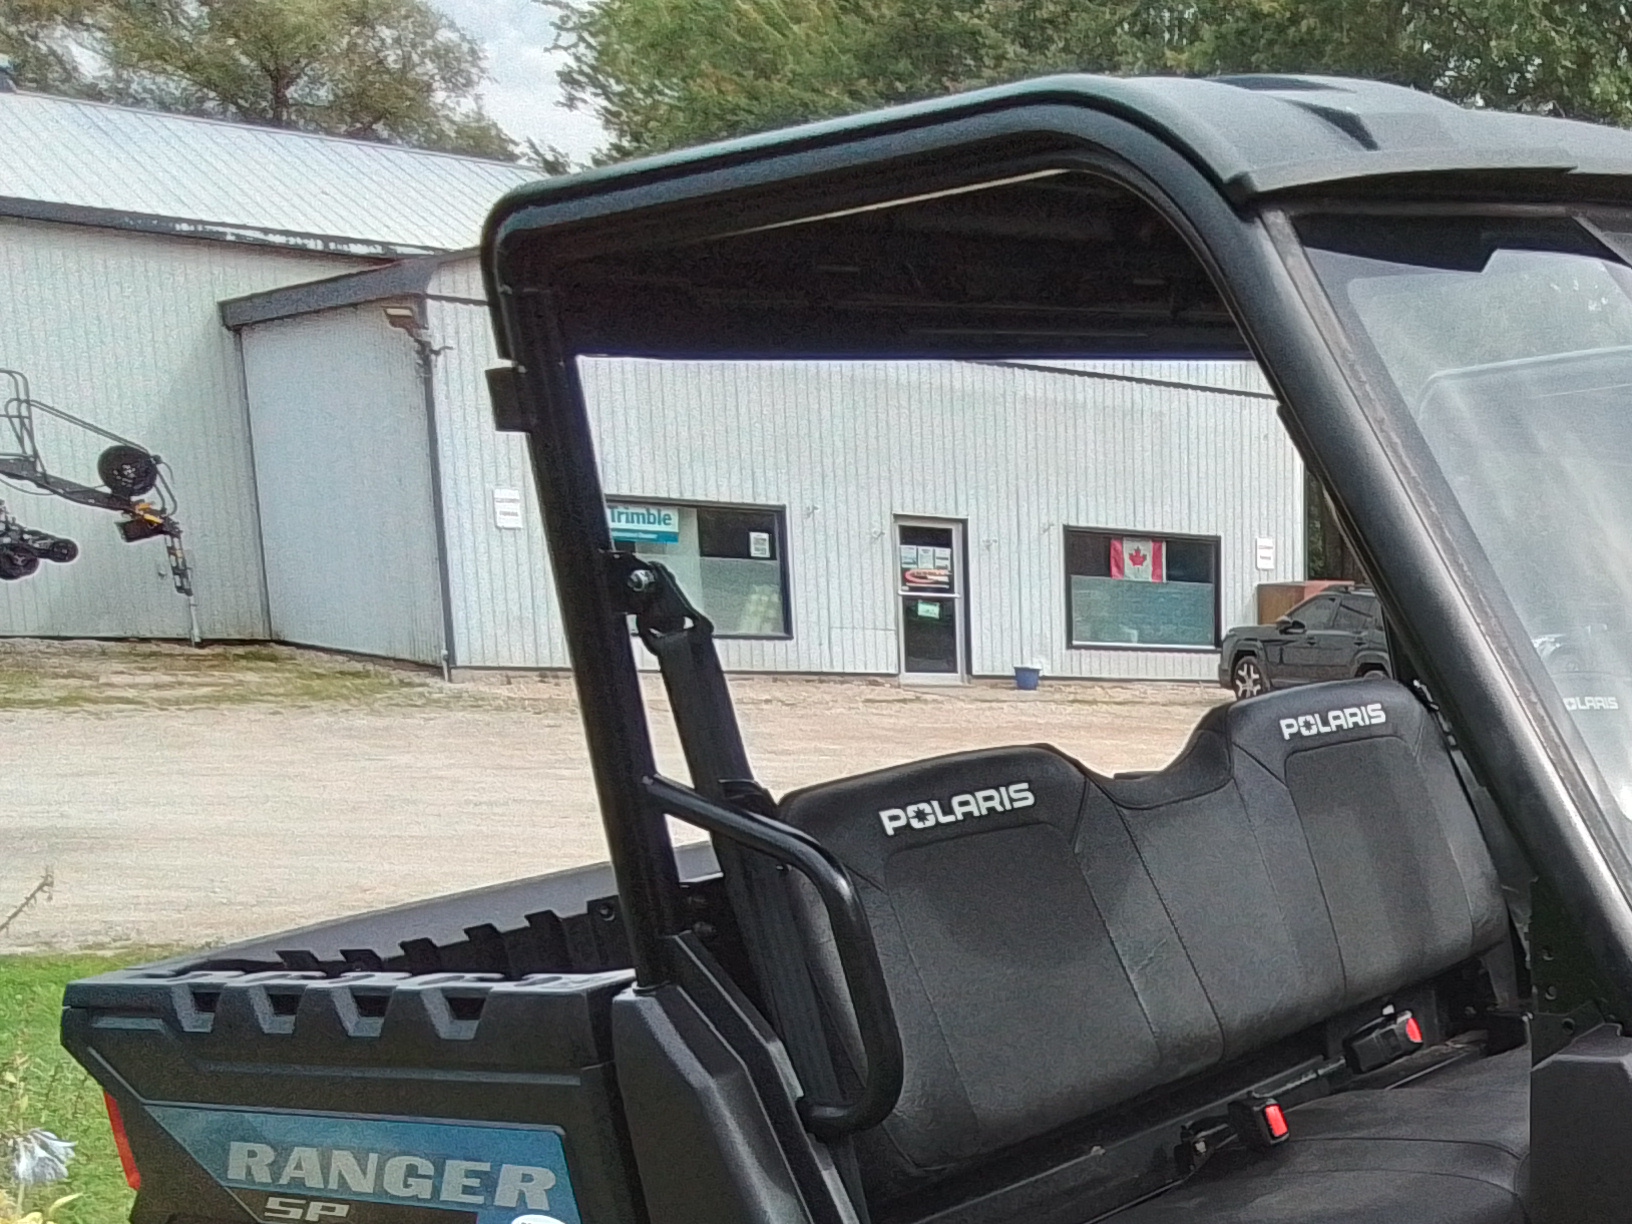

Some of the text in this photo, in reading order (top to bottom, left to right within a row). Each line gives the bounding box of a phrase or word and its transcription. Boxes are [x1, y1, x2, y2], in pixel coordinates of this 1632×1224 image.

[607, 504, 672, 526] Trimble
[1563, 696, 1619, 711] OLARIS
[1279, 703, 1387, 740] POLARIS
[878, 781, 1036, 837] POLARIS
[226, 1140, 557, 1212] RANGER
[264, 1196, 350, 1222] SP
